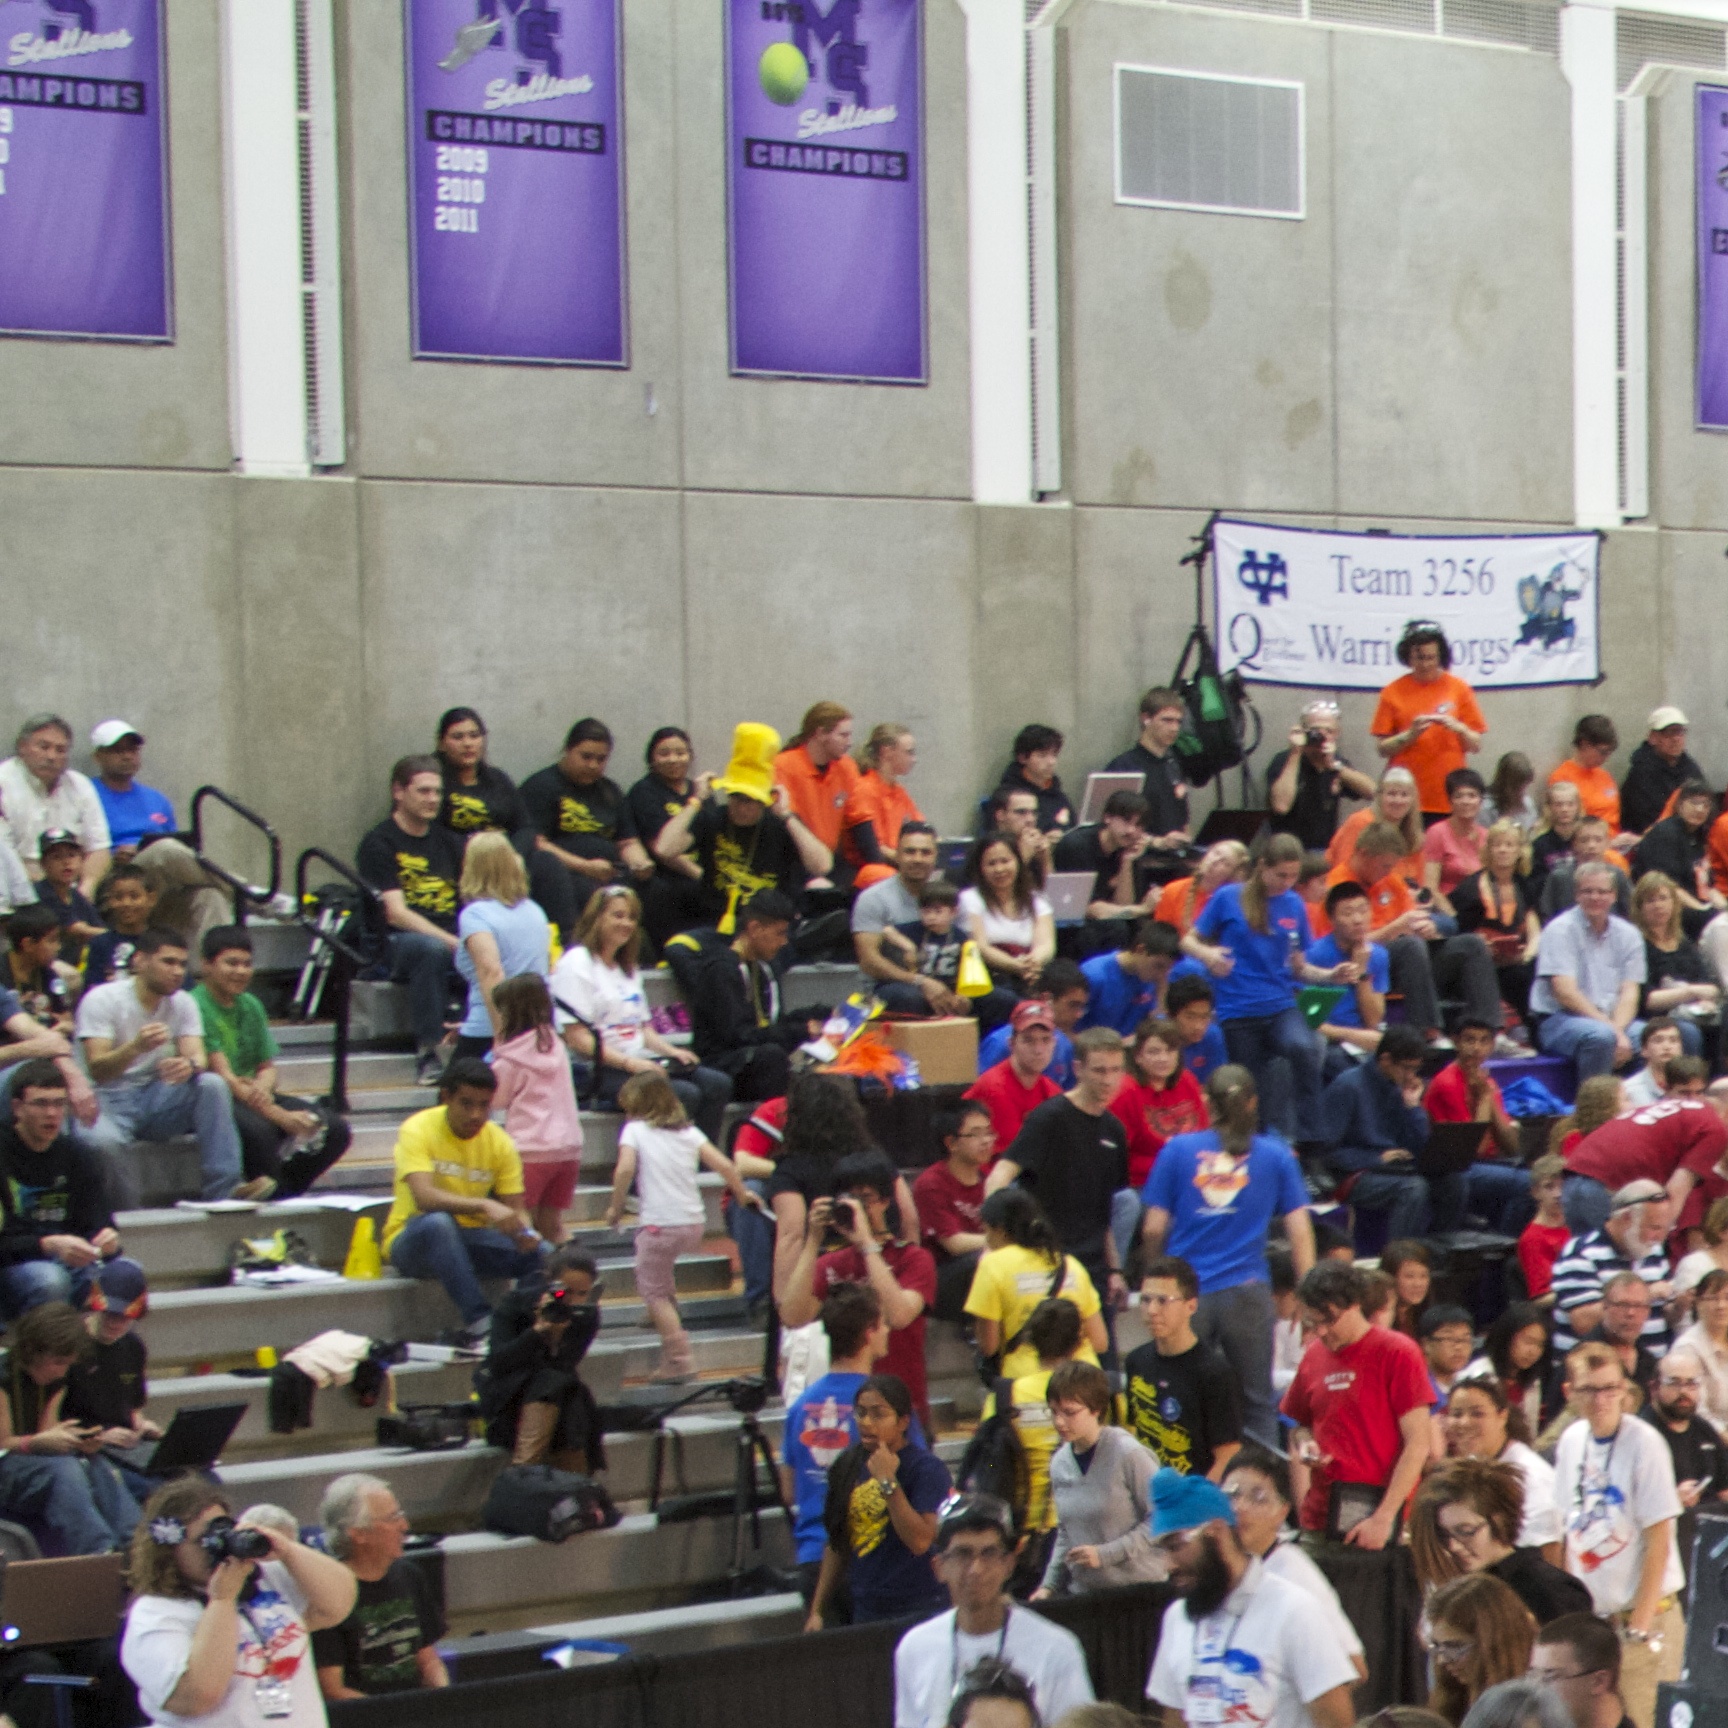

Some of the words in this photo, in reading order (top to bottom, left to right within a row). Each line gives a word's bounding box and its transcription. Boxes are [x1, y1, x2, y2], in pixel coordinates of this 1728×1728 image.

[434, 115, 601, 150] CHAMPIONS
[751, 143, 904, 177] CHAMPIONS
[436, 177, 486, 203] 2010
[434, 206, 479, 233] 2011
[1330, 555, 1411, 595] Team
[1422, 556, 1496, 597] 3256
[1310, 622, 1510, 672] Warriorgs
